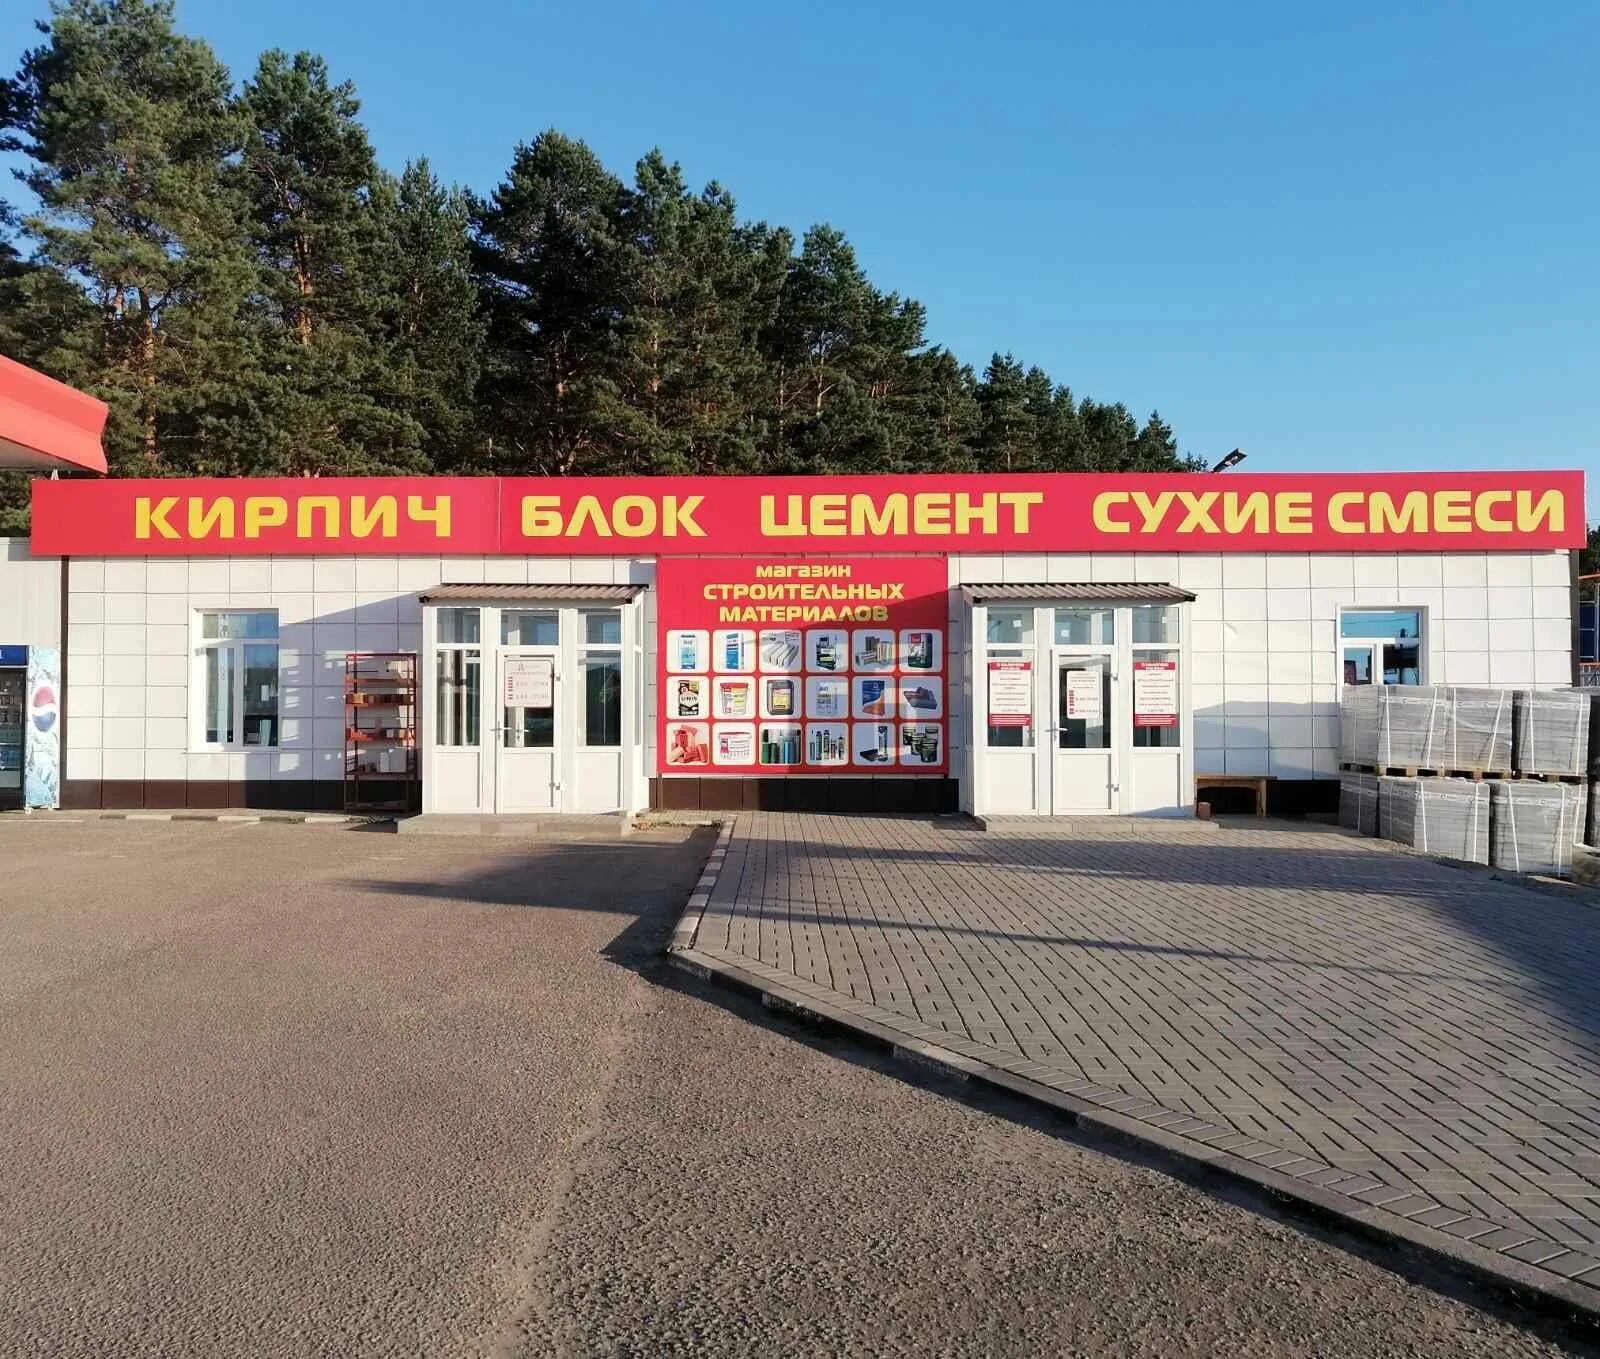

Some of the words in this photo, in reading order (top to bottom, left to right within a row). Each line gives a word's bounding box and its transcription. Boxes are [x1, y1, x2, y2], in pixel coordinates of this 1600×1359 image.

[134, 495, 452, 540] КИРПИЧ
[520, 495, 706, 538] БЛОК
[760, 492, 1044, 537] ЦЕМЕНТ
[1092, 490, 1314, 535] СУХИЕ
[1328, 489, 1565, 535] СМЕСИ
[755, 564, 852, 578] магазин
[703, 583, 905, 600] СТРОИТЕЛЬНЫХ
[719, 605, 888, 623] МАТЕРИАЛОВ
